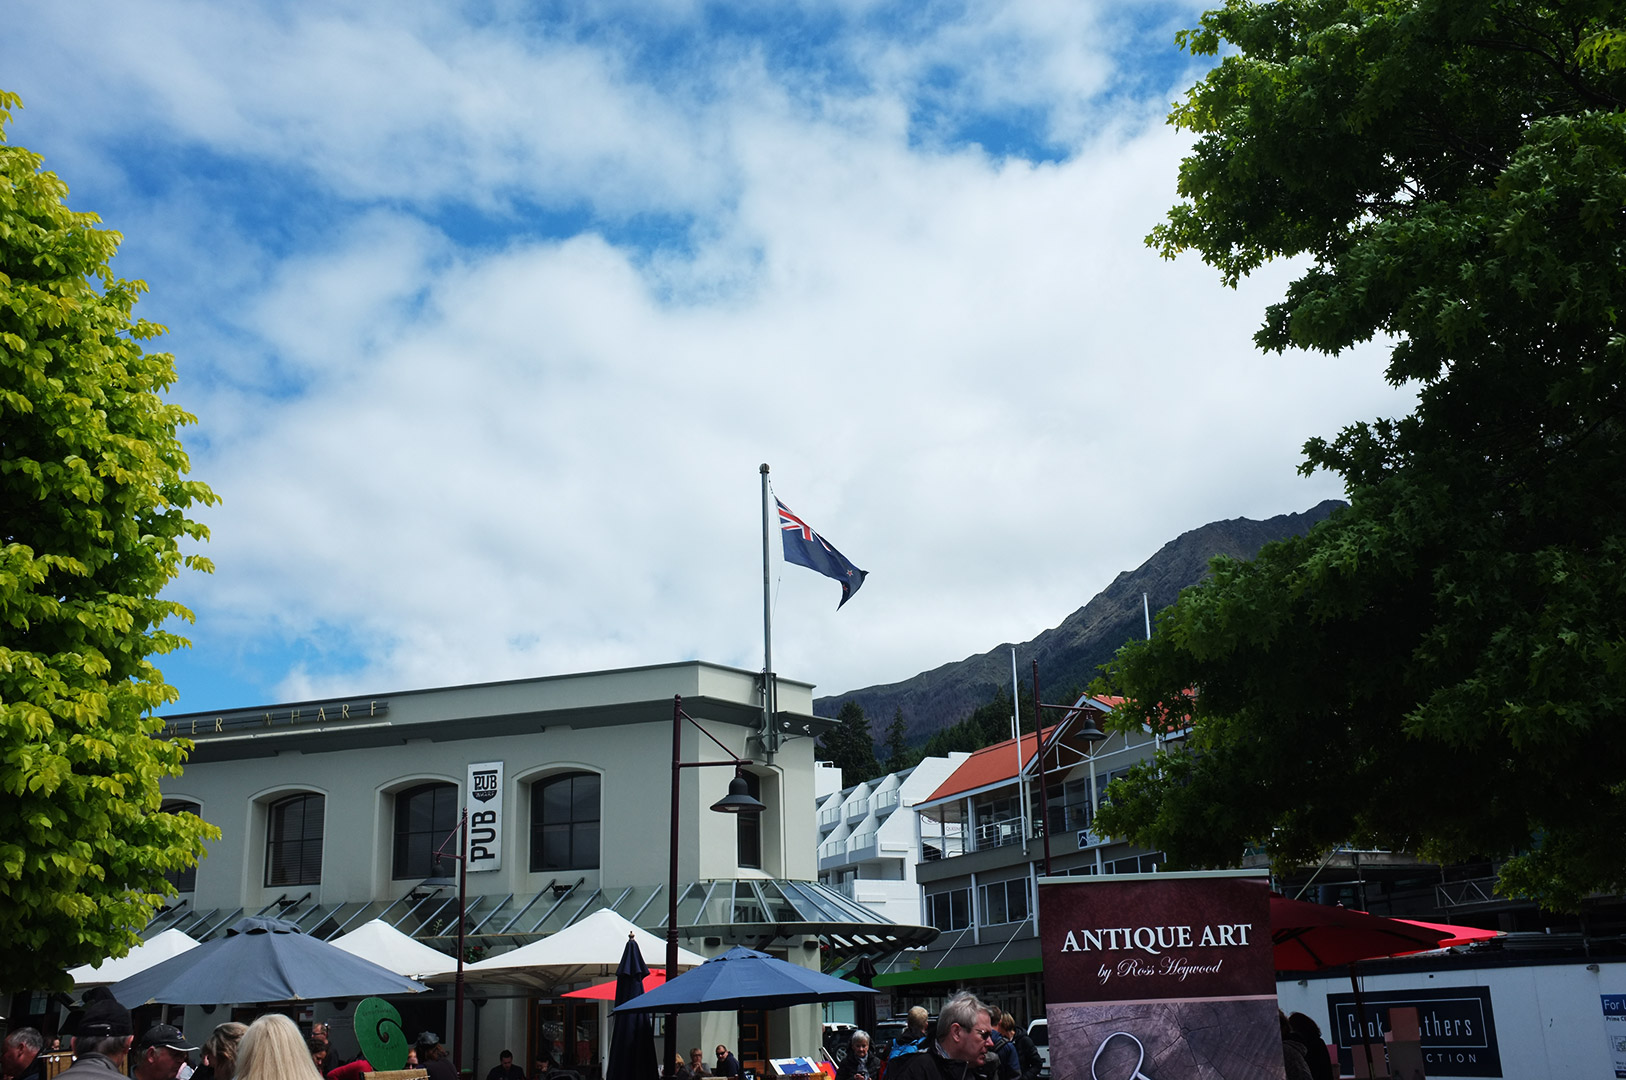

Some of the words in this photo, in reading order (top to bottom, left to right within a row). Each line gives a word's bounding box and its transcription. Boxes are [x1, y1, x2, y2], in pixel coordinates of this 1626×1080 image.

[262, 701, 378, 726] WHARF
[474, 775, 497, 790] PUB
[470, 810, 496, 863] PUB
[1061, 925, 1194, 955] ANTIQUE
[1198, 924, 1252, 947] ART
[1097, 963, 1112, 985] by
[1117, 958, 1155, 978] Ross
[1158, 956, 1223, 982] Heywood
[1603, 999, 1620, 1011] For
